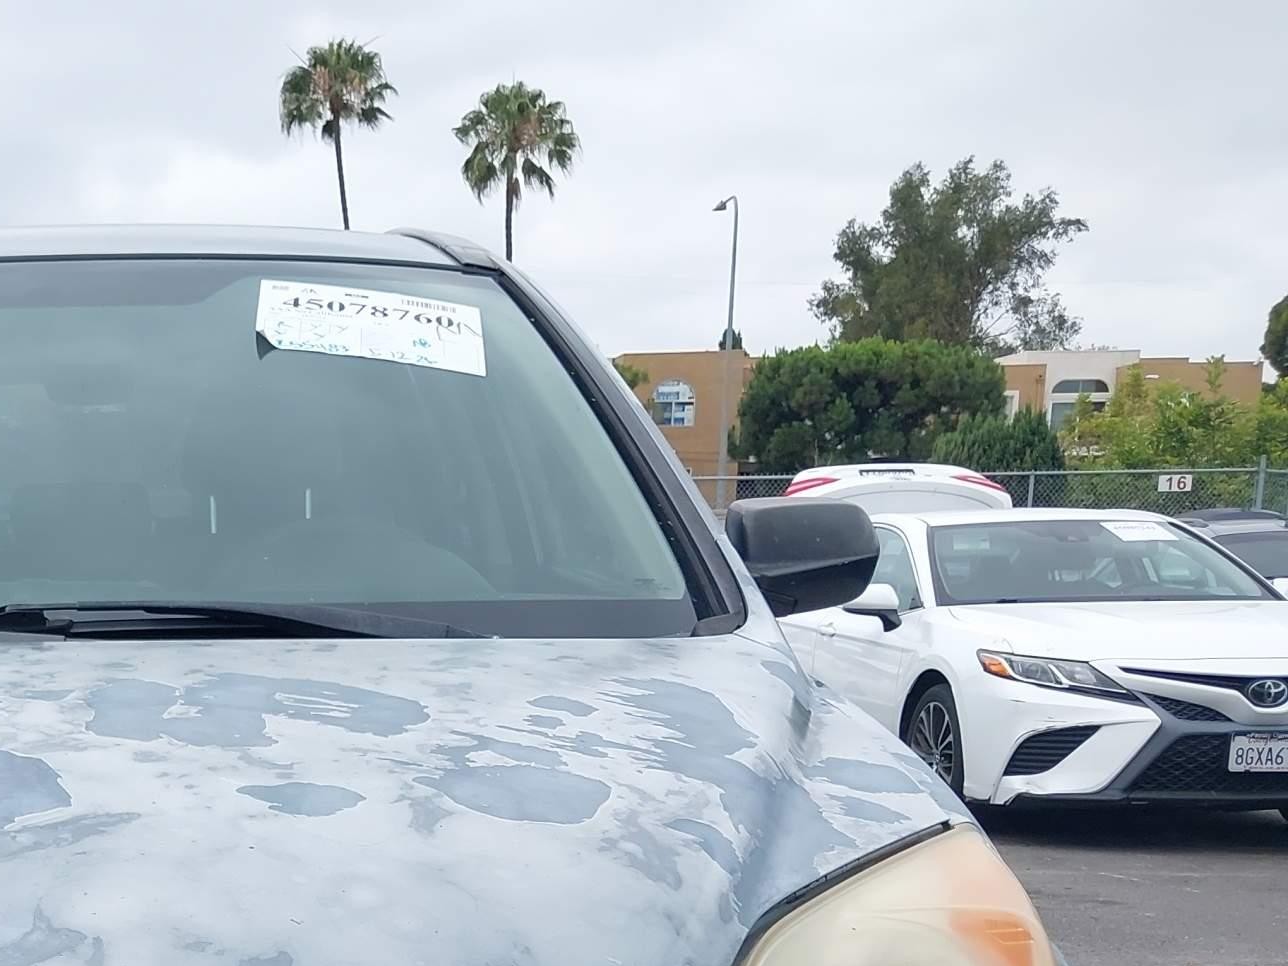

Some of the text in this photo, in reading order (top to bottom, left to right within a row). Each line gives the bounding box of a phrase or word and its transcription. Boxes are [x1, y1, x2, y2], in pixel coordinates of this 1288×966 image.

[282, 296, 455, 328] 45078760
[1166, 476, 1187, 491] 16
[1235, 746, 1288, 766] 8GXA6
